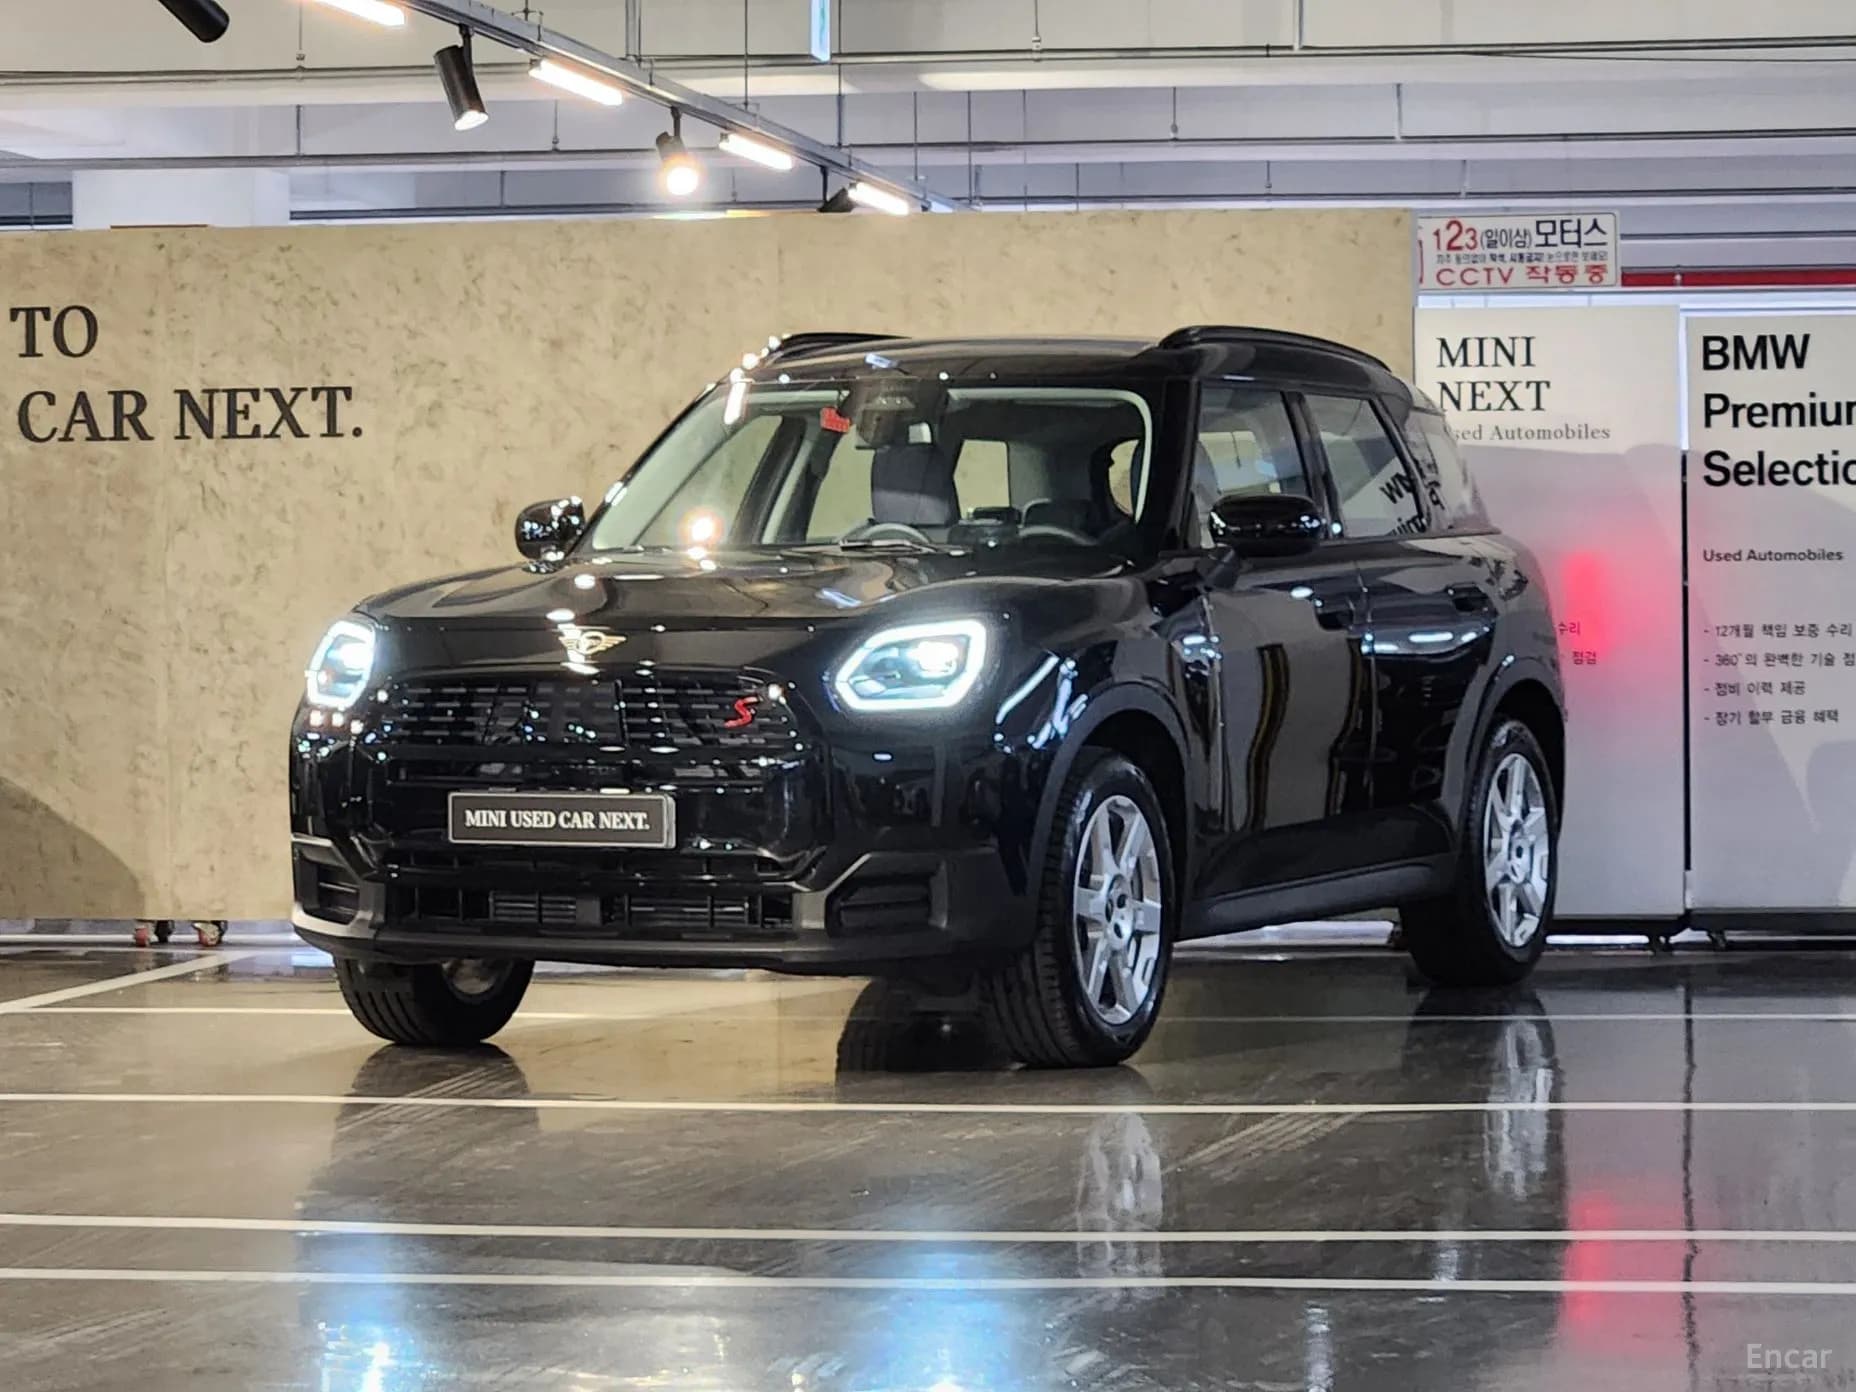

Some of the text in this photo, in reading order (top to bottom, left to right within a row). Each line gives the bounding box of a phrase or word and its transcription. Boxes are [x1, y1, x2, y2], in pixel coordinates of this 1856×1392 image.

[1535, 218, 1608, 248] 모터스
[1436, 267, 1514, 286] CCTV
[10, 305, 98, 358] TO
[1437, 336, 1536, 368] MINI
[1702, 333, 1811, 371] BMW
[1438, 381, 1550, 412] NEXT
[17, 386, 363, 443] CAR NEXT.
[1490, 423, 1611, 441] Automobiles
[1703, 548, 1843, 563] Used Automobiles
[1558, 621, 1581, 636] 수리
[1715, 623, 1853, 639] 12개월 책임 보증 수리
[1572, 650, 1597, 665] 점검
[1764, 653, 1803, 667] 완벽한
[1811, 652, 1836, 667] 기술
[1747, 682, 1773, 696] 이력
[1781, 681, 1806, 696] 제공
[724, 697, 760, 728] S
[1716, 711, 1742, 726] 장기
[1781, 710, 1806, 725] 금융
[465, 811, 650, 830] MINI USED CAR NEXT.
